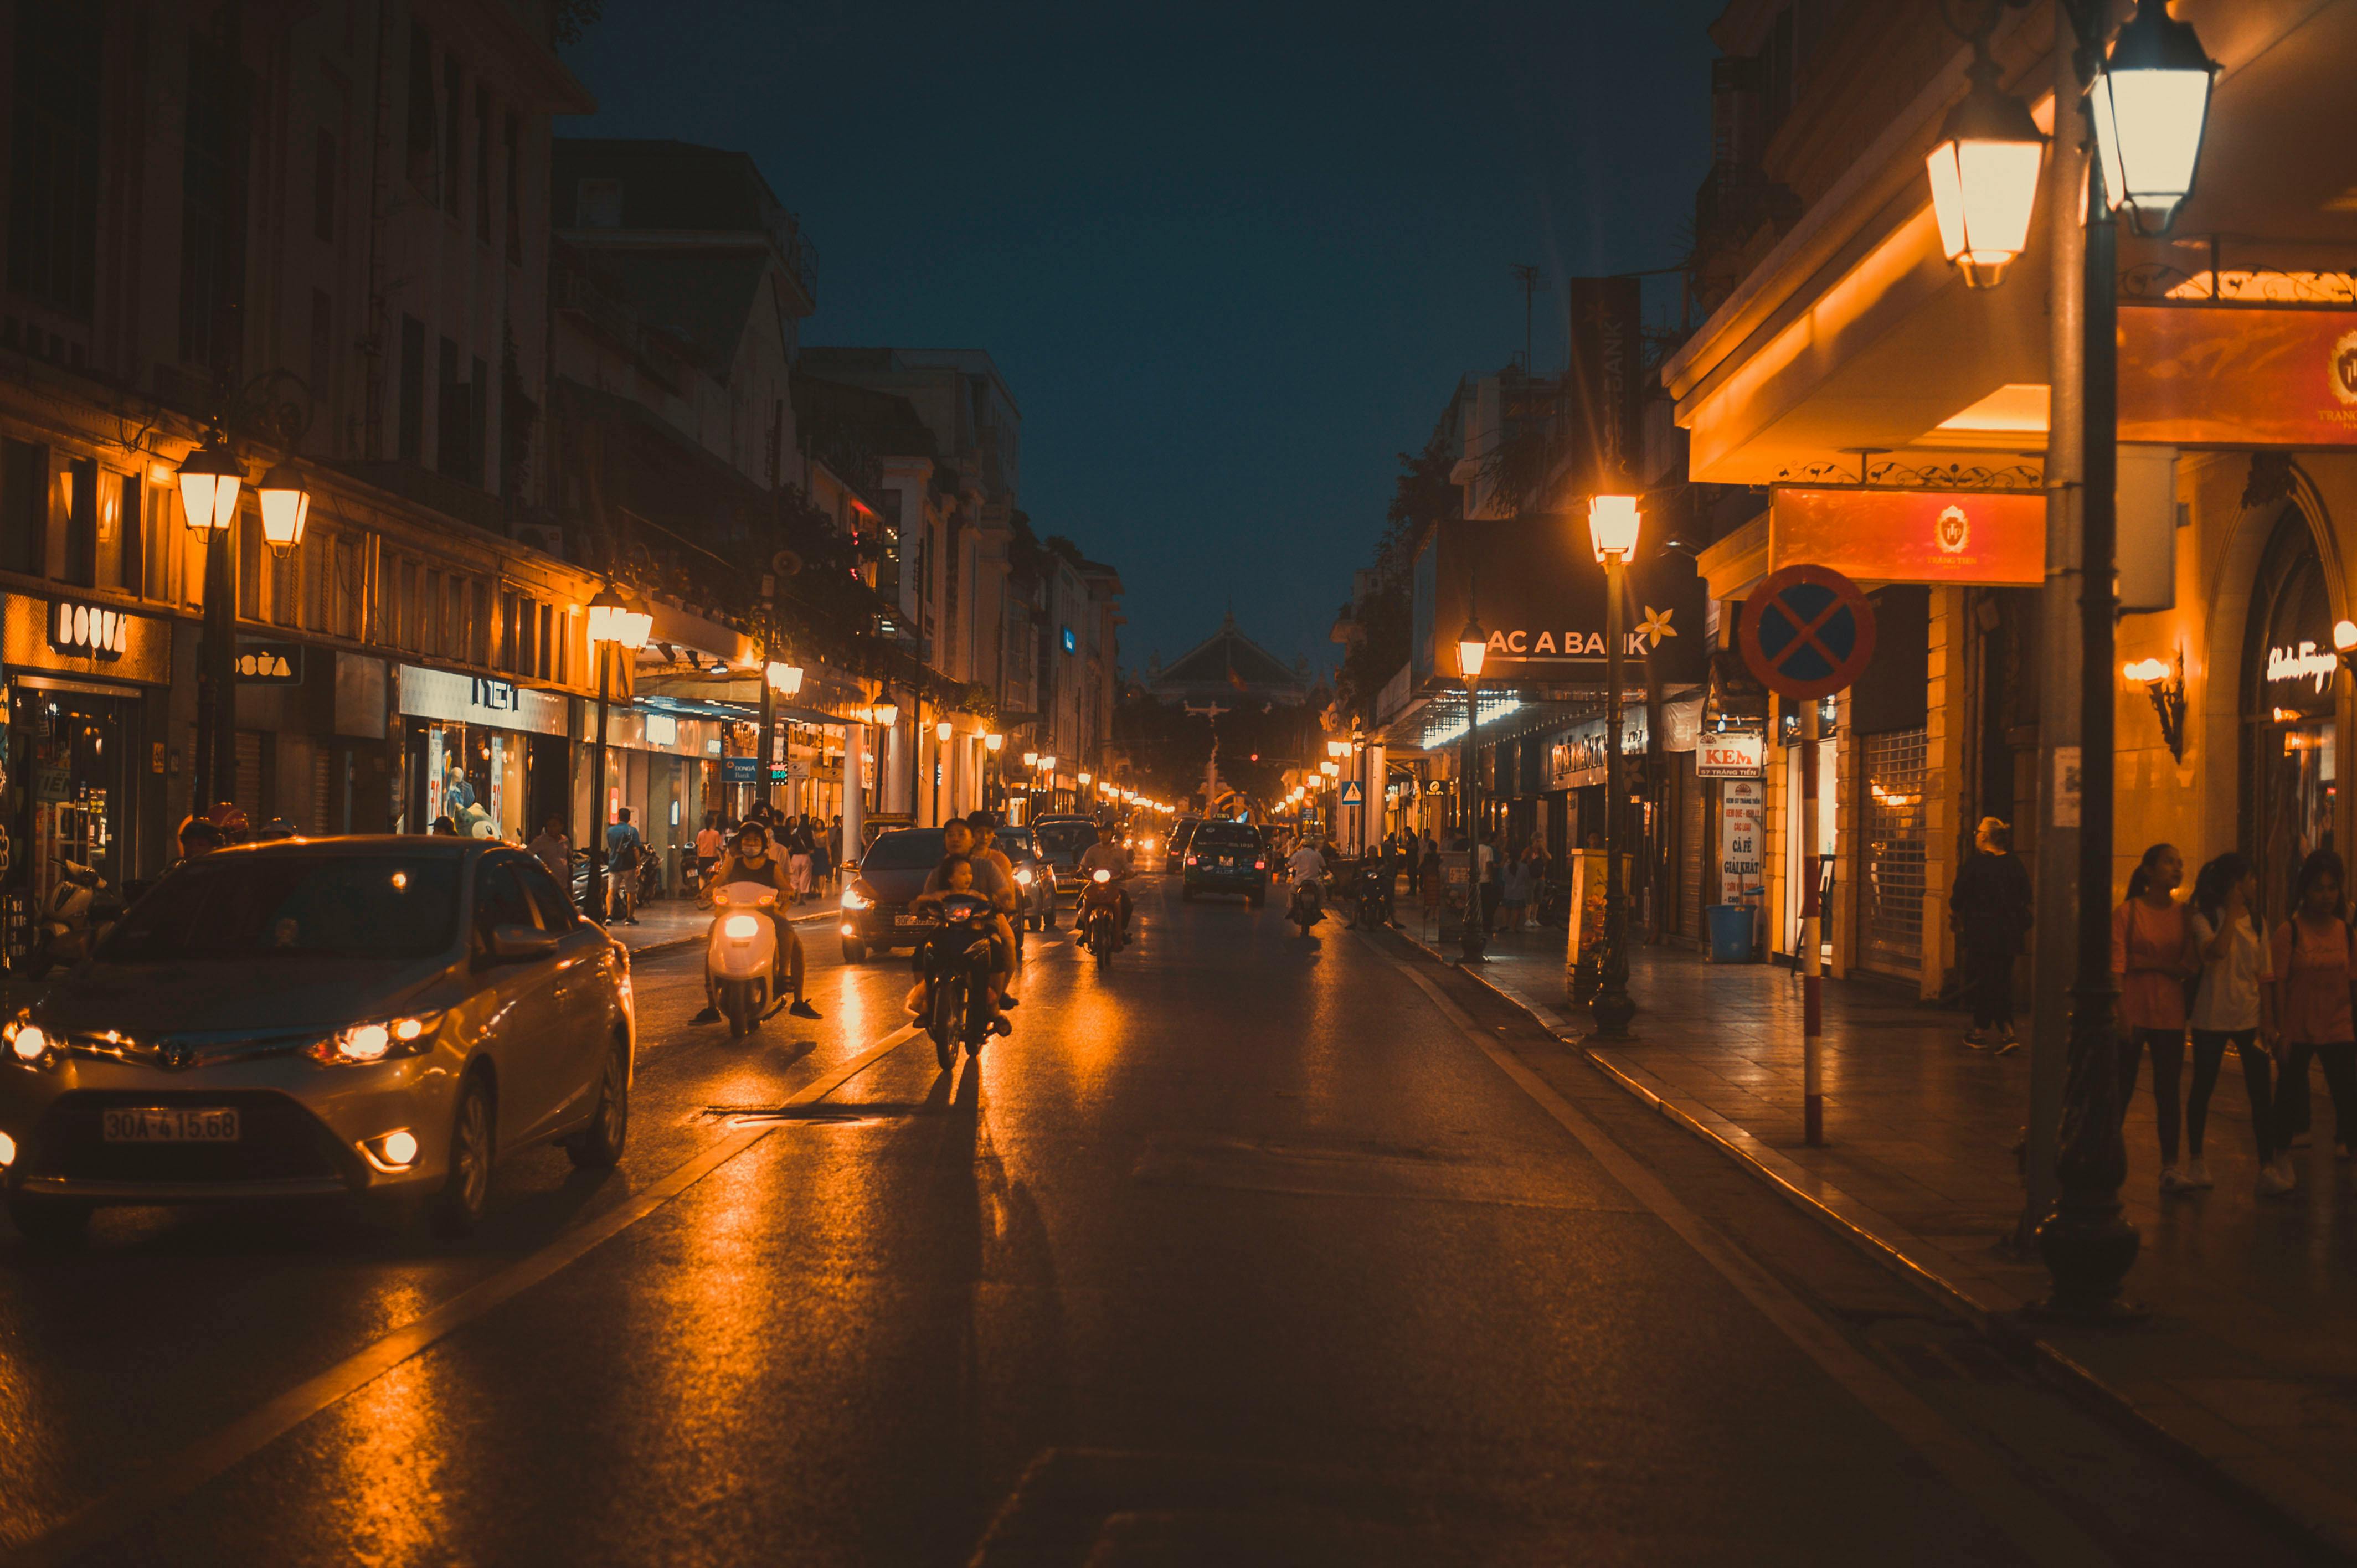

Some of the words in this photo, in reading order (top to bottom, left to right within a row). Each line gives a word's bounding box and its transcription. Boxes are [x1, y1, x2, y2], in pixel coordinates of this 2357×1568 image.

[1486, 630, 1527, 653] AC
[1534, 631, 1556, 653] A
[1565, 632, 1648, 655] BAK
[1705, 749, 1752, 765] KEM
